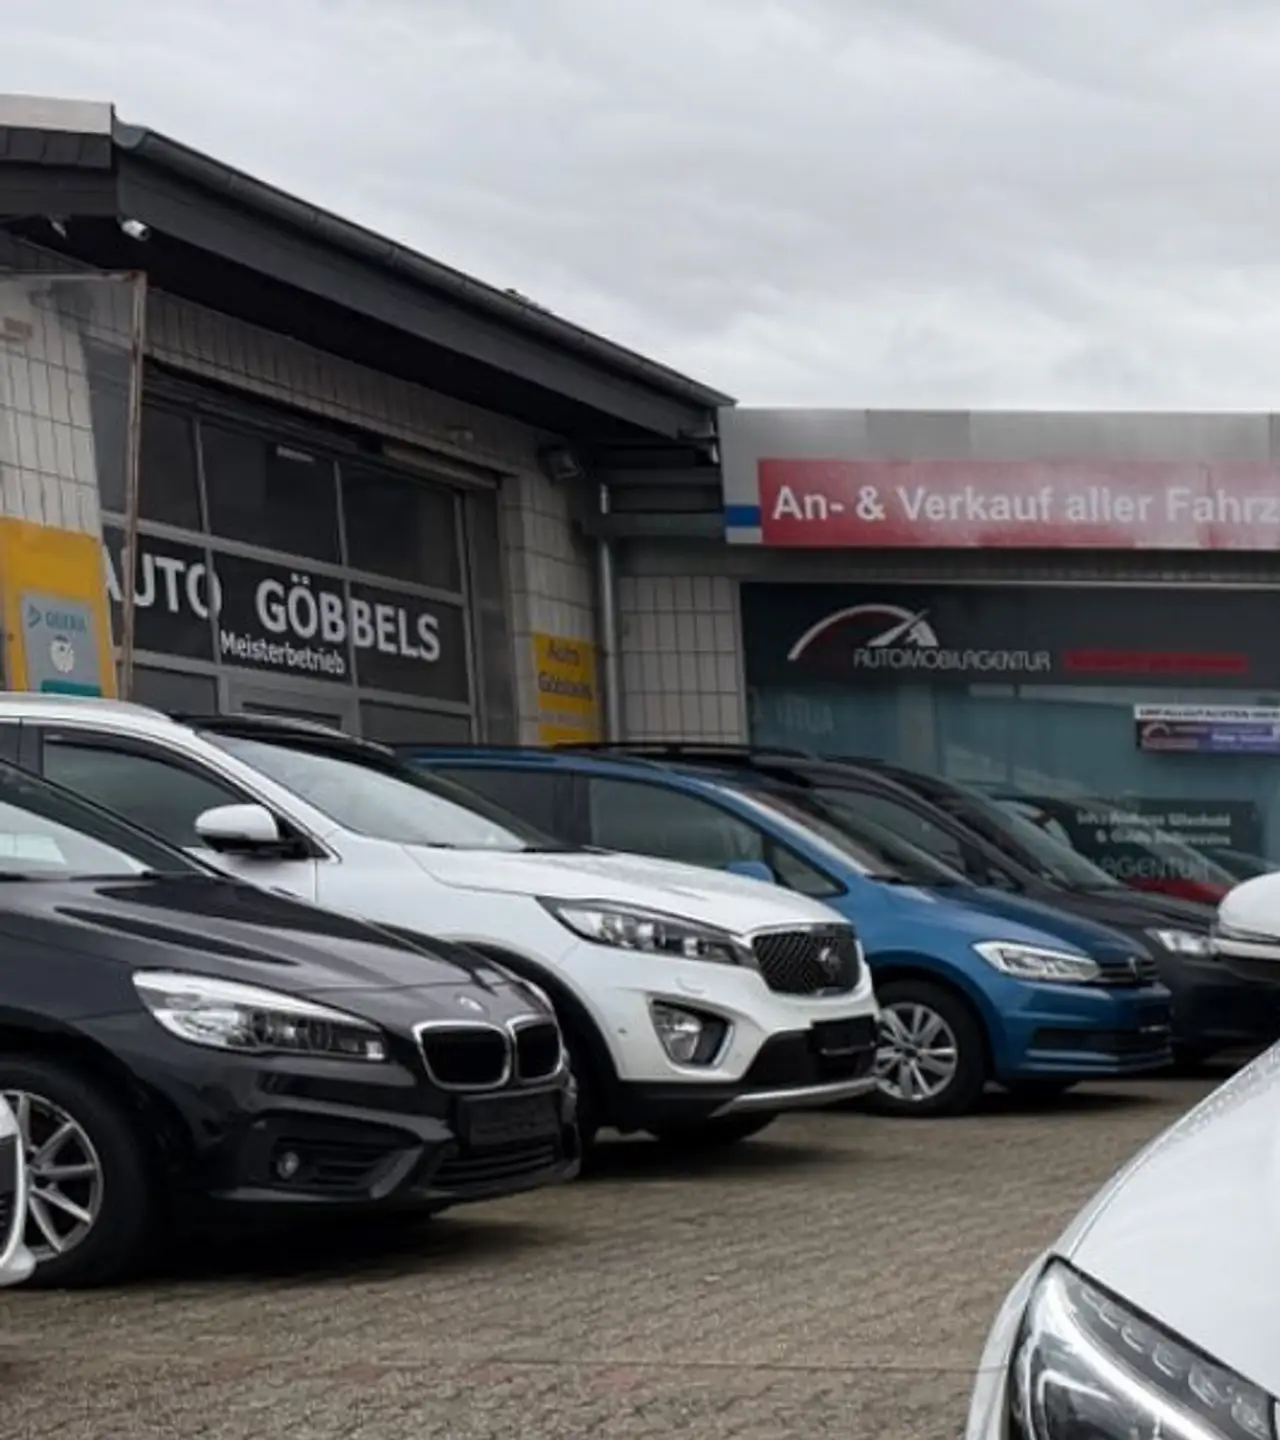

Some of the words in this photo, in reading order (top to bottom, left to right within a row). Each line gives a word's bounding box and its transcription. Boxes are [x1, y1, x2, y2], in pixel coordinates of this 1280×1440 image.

[772, 485, 844, 521] An-
[855, 485, 886, 521] &
[897, 484, 1053, 521] Verkauf
[1065, 487, 1153, 523] aller
[255, 572, 441, 663] GÖBBELS
[220, 628, 346, 675] Meisterbetrieb
